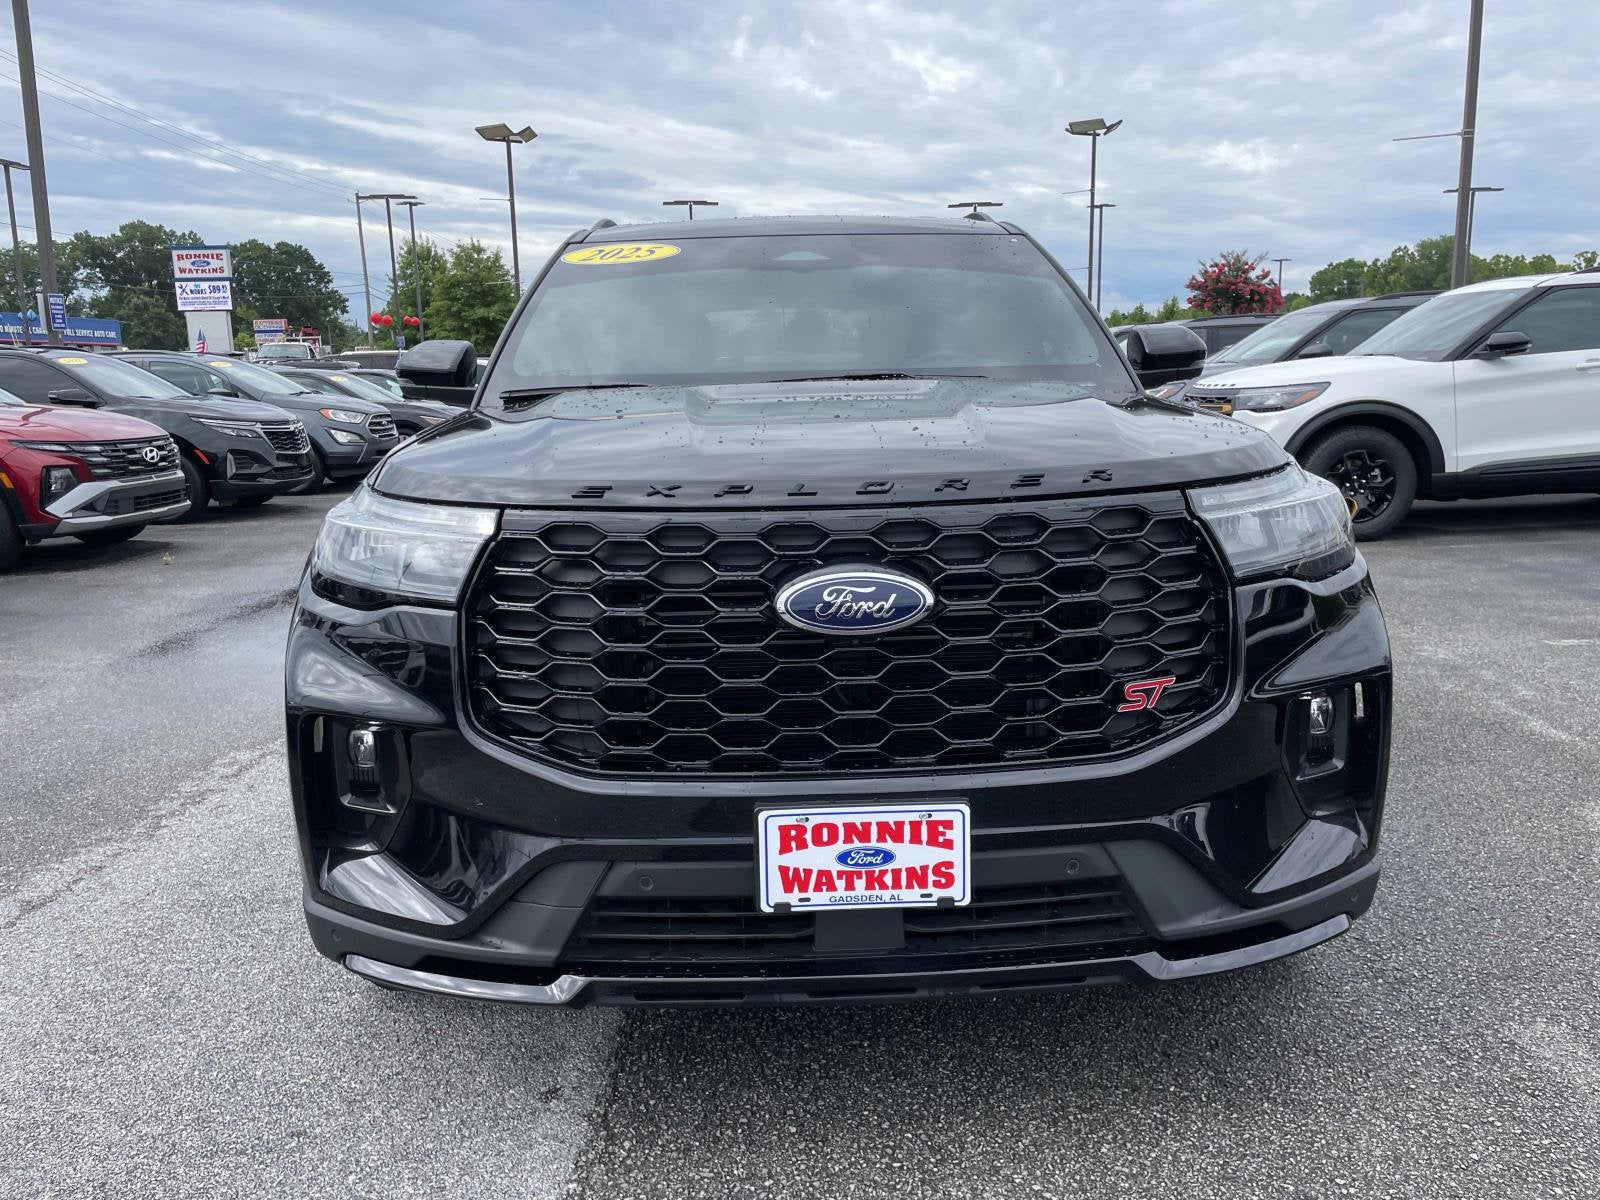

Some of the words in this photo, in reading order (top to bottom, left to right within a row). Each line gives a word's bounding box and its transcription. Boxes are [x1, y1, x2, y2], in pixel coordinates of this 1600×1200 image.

[176, 253, 223, 261] RONNIE
[578, 246, 663, 261] 2025
[178, 266, 224, 274] WATKINS
[5, 325, 24, 334] MINUTE
[76, 329, 93, 337] SERVICE
[94, 330, 105, 338] AUTO
[571, 468, 1113, 499] EXPLORER
[814, 585, 897, 620] Ford
[1117, 676, 1177, 713] ST
[778, 819, 954, 855] RONNIE
[847, 849, 884, 865] Ford
[778, 860, 956, 894] WATKINS
[829, 894, 886, 904] GADSDEN,
[889, 894, 904, 902] AL
